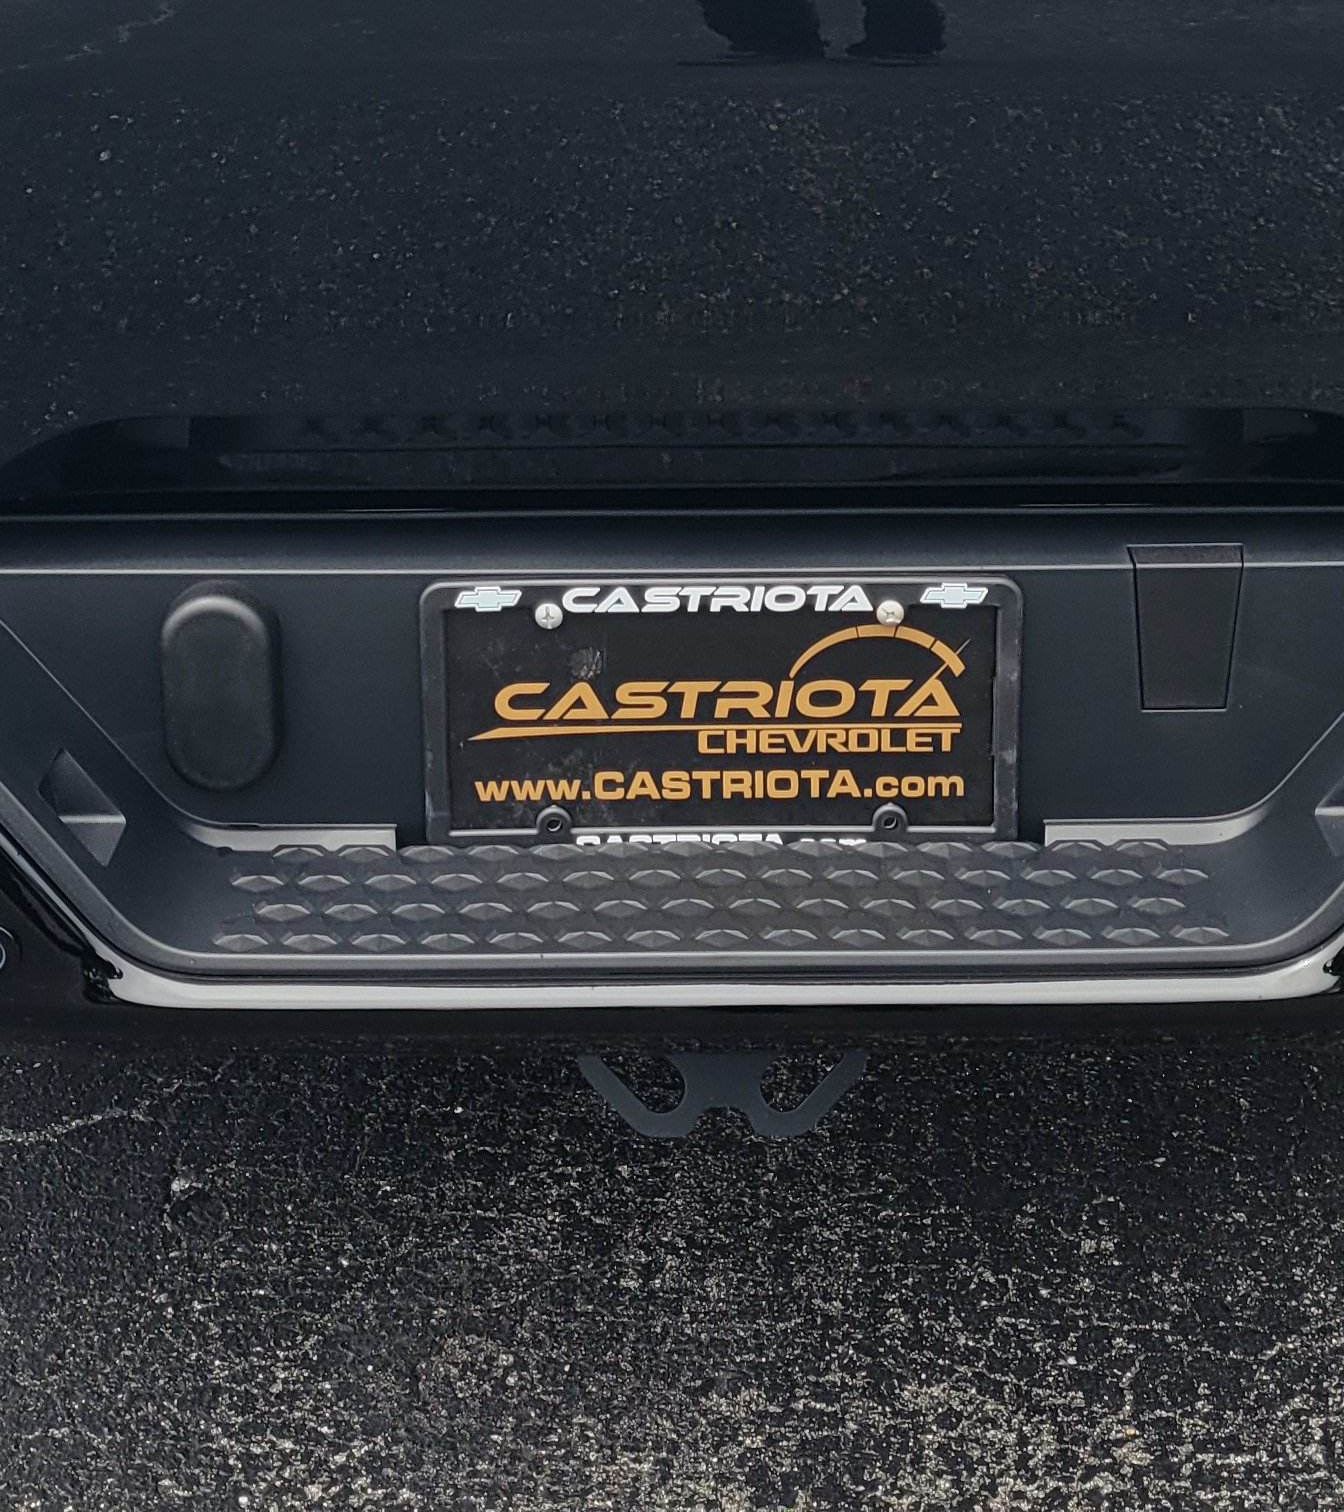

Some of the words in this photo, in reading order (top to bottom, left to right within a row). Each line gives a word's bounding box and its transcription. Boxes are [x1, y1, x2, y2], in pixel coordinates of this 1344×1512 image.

[561, 585, 874, 614] CASTRIOTA
[494, 679, 961, 721] CASTRIOTA
[697, 729, 961, 755] CHEVROLET
[474, 769, 965, 802] www.CASTRIOTA.com
